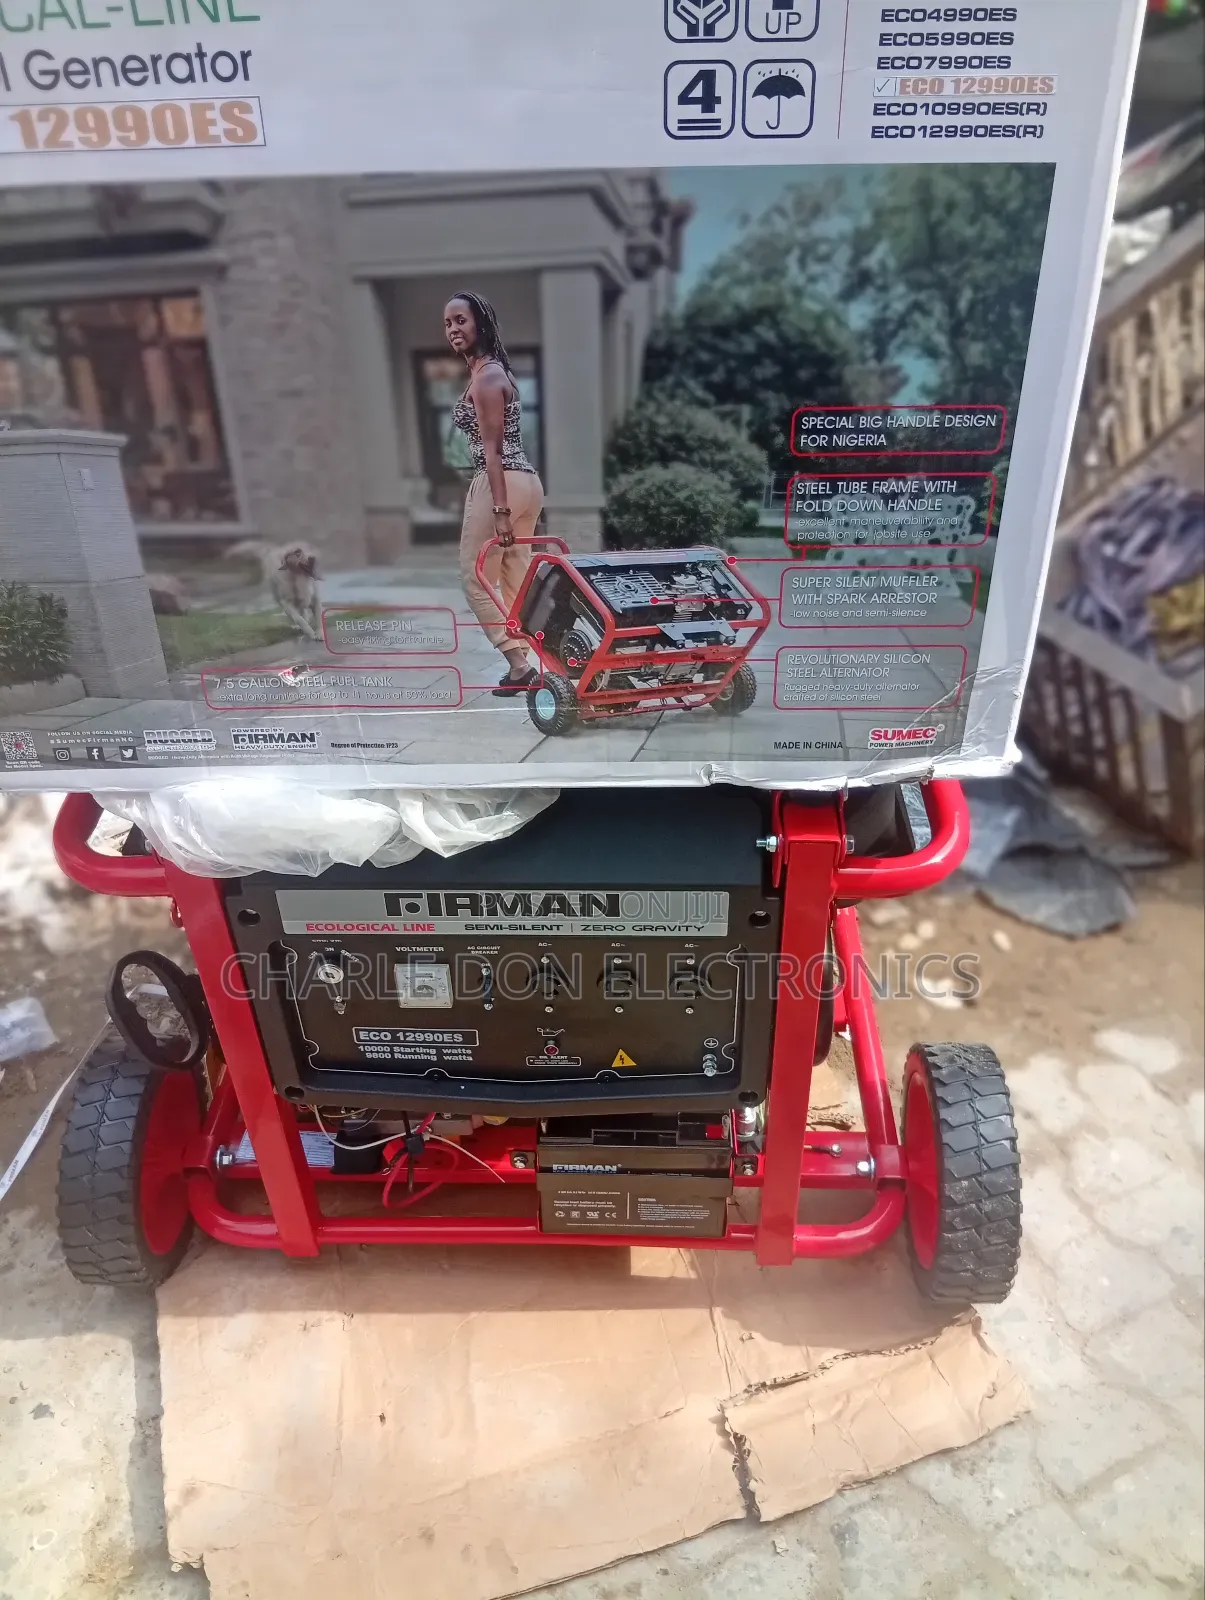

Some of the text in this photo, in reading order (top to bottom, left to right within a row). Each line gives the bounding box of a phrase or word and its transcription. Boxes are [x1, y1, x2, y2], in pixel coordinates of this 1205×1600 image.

[880, 7, 1018, 23] ECO4990ES
[764, 11, 802, 36] UP
[878, 31, 1015, 47] ECO5990ES
[23, 42, 252, 92] Generator
[876, 55, 1012, 71] ECO7990ES
[677, 69, 721, 114] 4
[899, 76, 1055, 96] ECO 12990ES
[872, 101, 1048, 117] ECO10990ES(R)
[9, 100, 259, 151] 12990ES
[870, 124, 1045, 140] ECO12990ES(R)
[801, 414, 997, 429] SPECIAL BIG HANDLE DESIGN
[800, 434, 887, 447] FOR NIGERIA
[796, 480, 957, 495] STEEL TUBE FRAME WITH
[795, 498, 943, 513] FOLD DOWN HANDLE
[850, 516, 935, 528] maneuverability
[936, 515, 959, 526] and
[797, 529, 931, 541] protection for jobsite use
[792, 575, 939, 588] SUPER SILENT MUFFLER
[791, 592, 938, 605] WITH SPARK ARRESTOR
[812, 609, 840, 618] noise
[841, 608, 863, 618] and
[864, 608, 928, 618] semi-silence
[335, 620, 413, 632] RELEASE PIN
[787, 653, 931, 665] REVOLUTIONARY SILICON
[786, 667, 890, 678] STEEL ALTERNATOR
[329, 675, 359, 687] FUEL
[360, 676, 394, 687] TANK
[783, 682, 920, 693] Rugged heavy-duty alternator
[830, 693, 859, 701] silicon
[232, 732, 317, 745] FIRMAN
[870, 727, 936, 741] SUMEC
[773, 741, 844, 750] MADE IN CHINA
[894, 739, 934, 747] MACHINERY
[305, 923, 705, 933] ECOLOGICAL LINE SEMI-SILENT ZERO GRAVITY
[358, 1031, 464, 1042] ECO 12990ES
[393, 1046, 437, 1054] Starting
[394, 1053, 437, 1061] Running
[552, 1163, 617, 1172] FIRMAN
